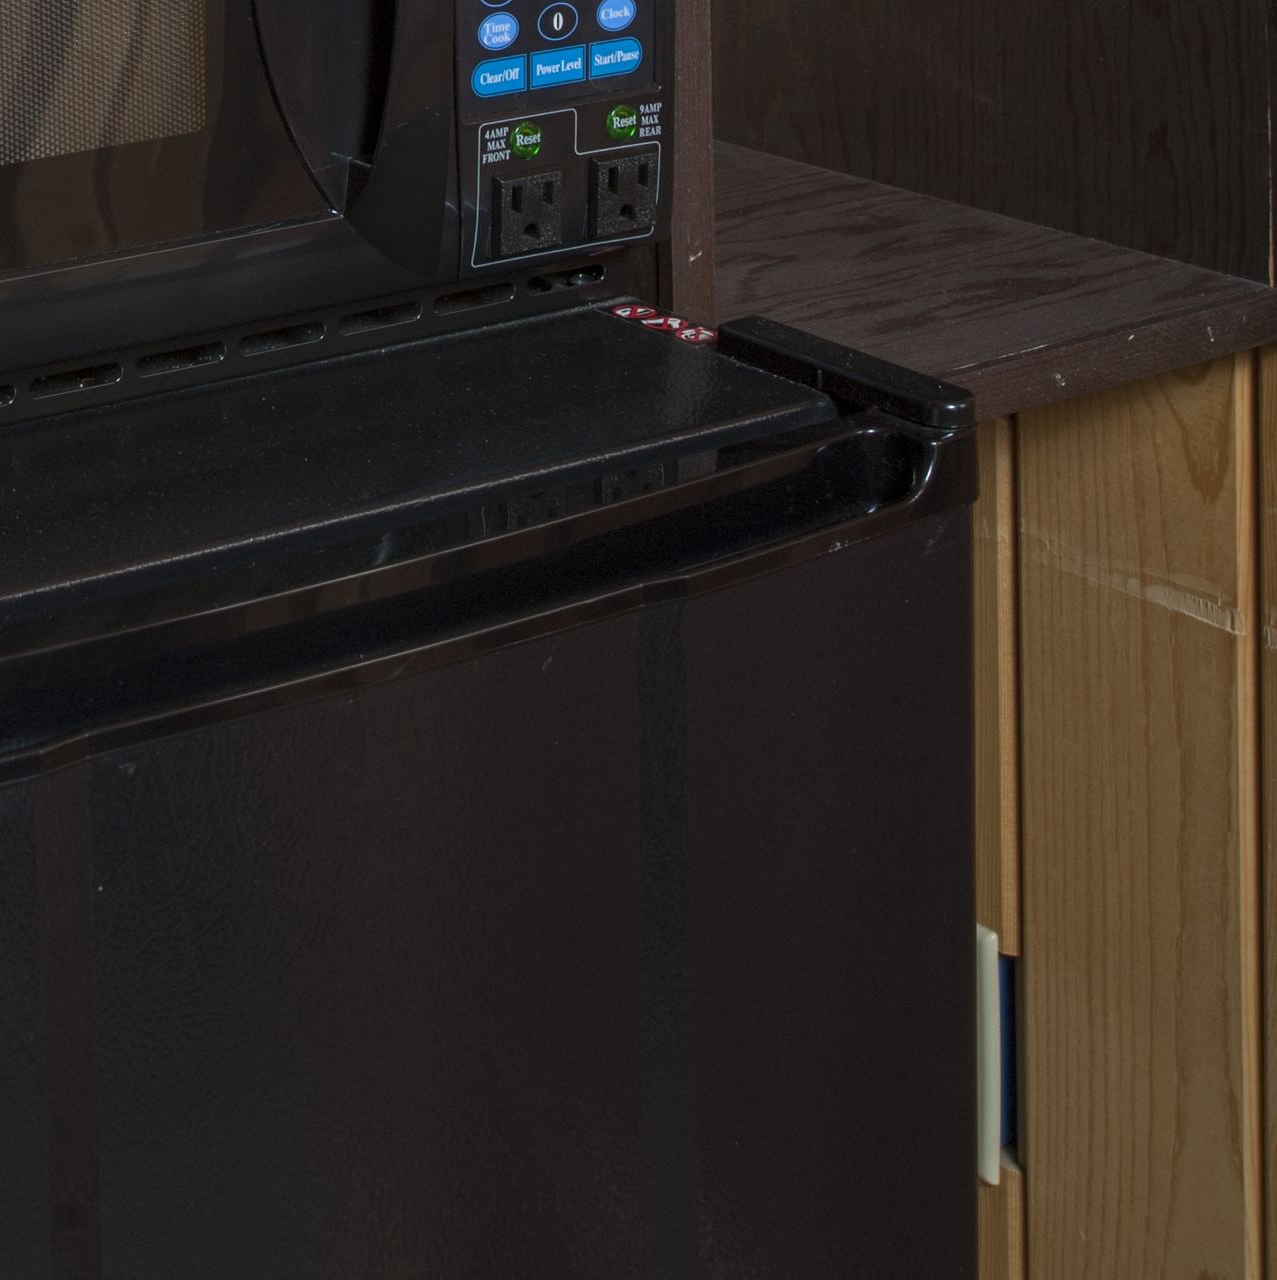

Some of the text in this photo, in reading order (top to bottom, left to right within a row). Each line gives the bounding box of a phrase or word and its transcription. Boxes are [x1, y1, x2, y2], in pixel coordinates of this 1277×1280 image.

[552, 11, 564, 31] 0
[601, 6, 631, 21] Clock
[483, 22, 511, 34] Time
[483, 31, 511, 46] Cook
[594, 49, 640, 67] Start/Pause
[536, 57, 582, 76] Power Level
[480, 67, 520, 86] Clear/Off
[639, 102, 662, 114] 9AMP
[613, 115, 637, 129] Reset
[641, 114, 659, 126] MAX
[484, 126, 509, 139] 4AMP
[515, 132, 541, 147] Reset
[639, 126, 662, 138] REAR
[487, 141, 507, 152] MAX
[482, 150, 511, 165] FRONT
